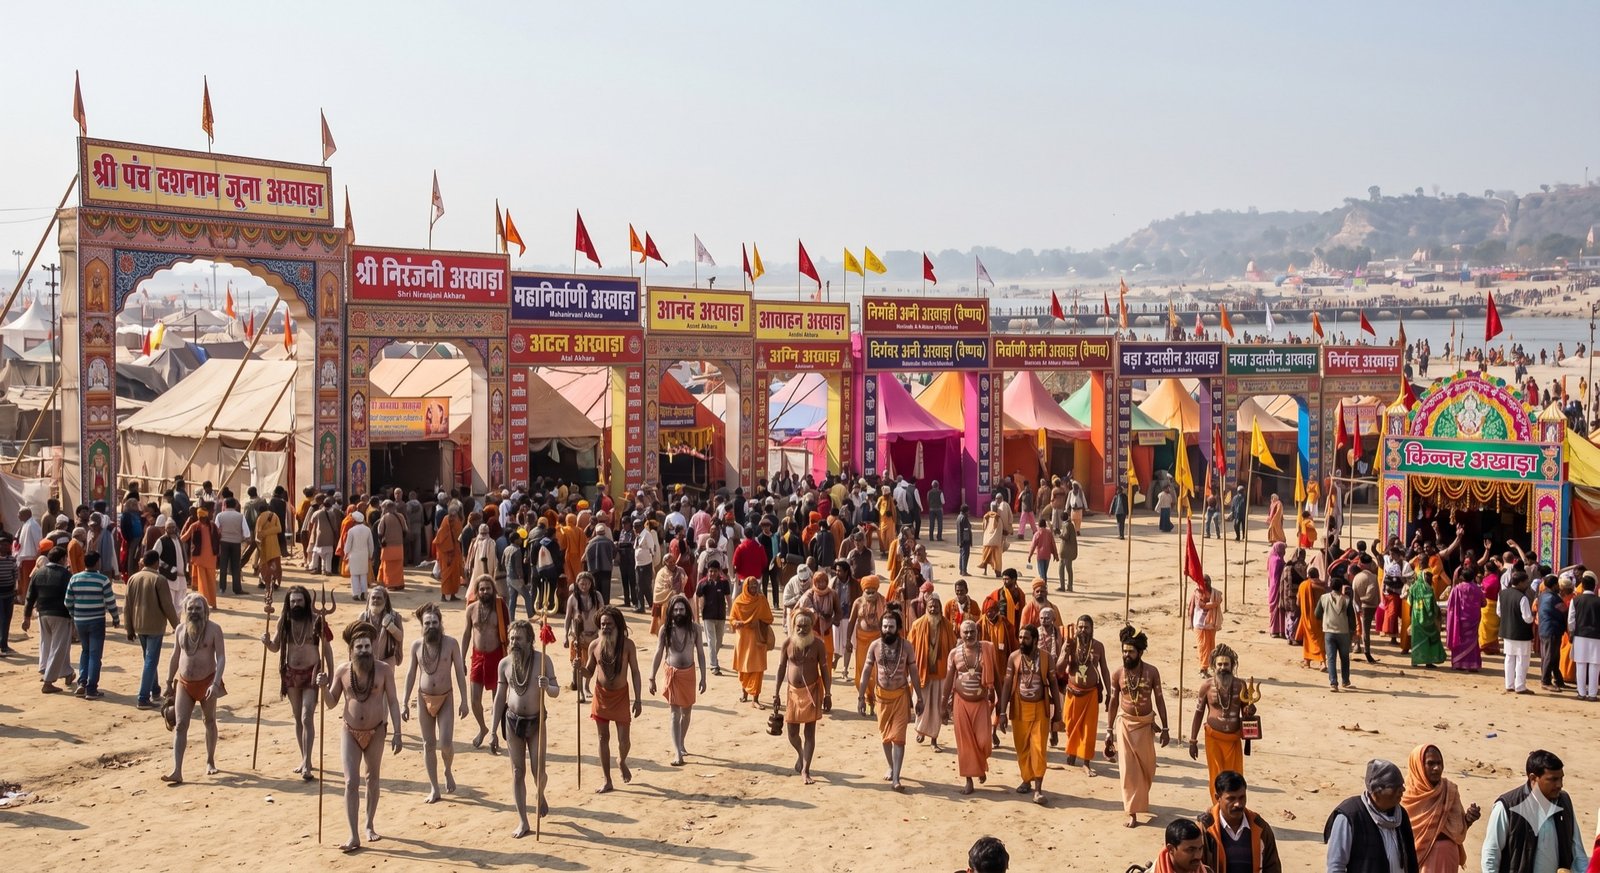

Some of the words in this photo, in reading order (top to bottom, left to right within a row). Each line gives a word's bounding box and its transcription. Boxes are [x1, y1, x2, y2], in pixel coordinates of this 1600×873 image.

[92, 153, 117, 189] श्री
[122, 155, 152, 191] पंच
[155, 166, 220, 198] दशनाम
[225, 174, 262, 209] जूना
[266, 178, 324, 214] अखाड़ा
[355, 256, 378, 286] श्री
[382, 257, 444, 289] निरंजनी
[450, 267, 504, 296] अखाड़ा
[397, 290, 411, 298] Shri
[412, 291, 442, 300] Niranjani
[514, 281, 588, 309] महानिर्वाणी
[591, 289, 636, 315] अखाड़ा
[549, 310, 583, 319] Mahanirvani
[657, 295, 695, 320] आनंद
[700, 302, 744, 327] अखाड़ा
[900, 303, 919, 321] अनी
[922, 307, 951, 323] अखाड़ा
[954, 303, 986, 325] (वैष्णव)
[759, 311, 803, 329] आवाहन
[807, 312, 845, 335] अखाड़ा
[530, 334, 570, 352] अटल
[574, 335, 625, 357] अखाड़ा
[769, 346, 799, 363] अग्नि
[802, 350, 840, 366] अखाड़ा
[901, 341, 920, 358] अनी
[923, 344, 952, 360] अखाड़ा
[955, 340, 986, 361] (वैष्णव)
[995, 340, 1027, 357] निर्वाणी
[1029, 340, 1047, 357] अनी
[1049, 344, 1077, 360] अखाड़ा
[1080, 340, 1110, 361] (वैष्णव)
[1123, 352, 1142, 369] बड़ा
[1144, 347, 1182, 366] उदासीन
[1185, 351, 1219, 368] अखाड़ा
[1229, 353, 1248, 366] नया
[1249, 349, 1283, 366] उदासीन
[1285, 353, 1316, 368] अखाड़ा
[1362, 355, 1399, 371] अखाड़ा
[1404, 441, 1467, 468] किन्नर
[1469, 451, 1539, 477] अखाड़ा
